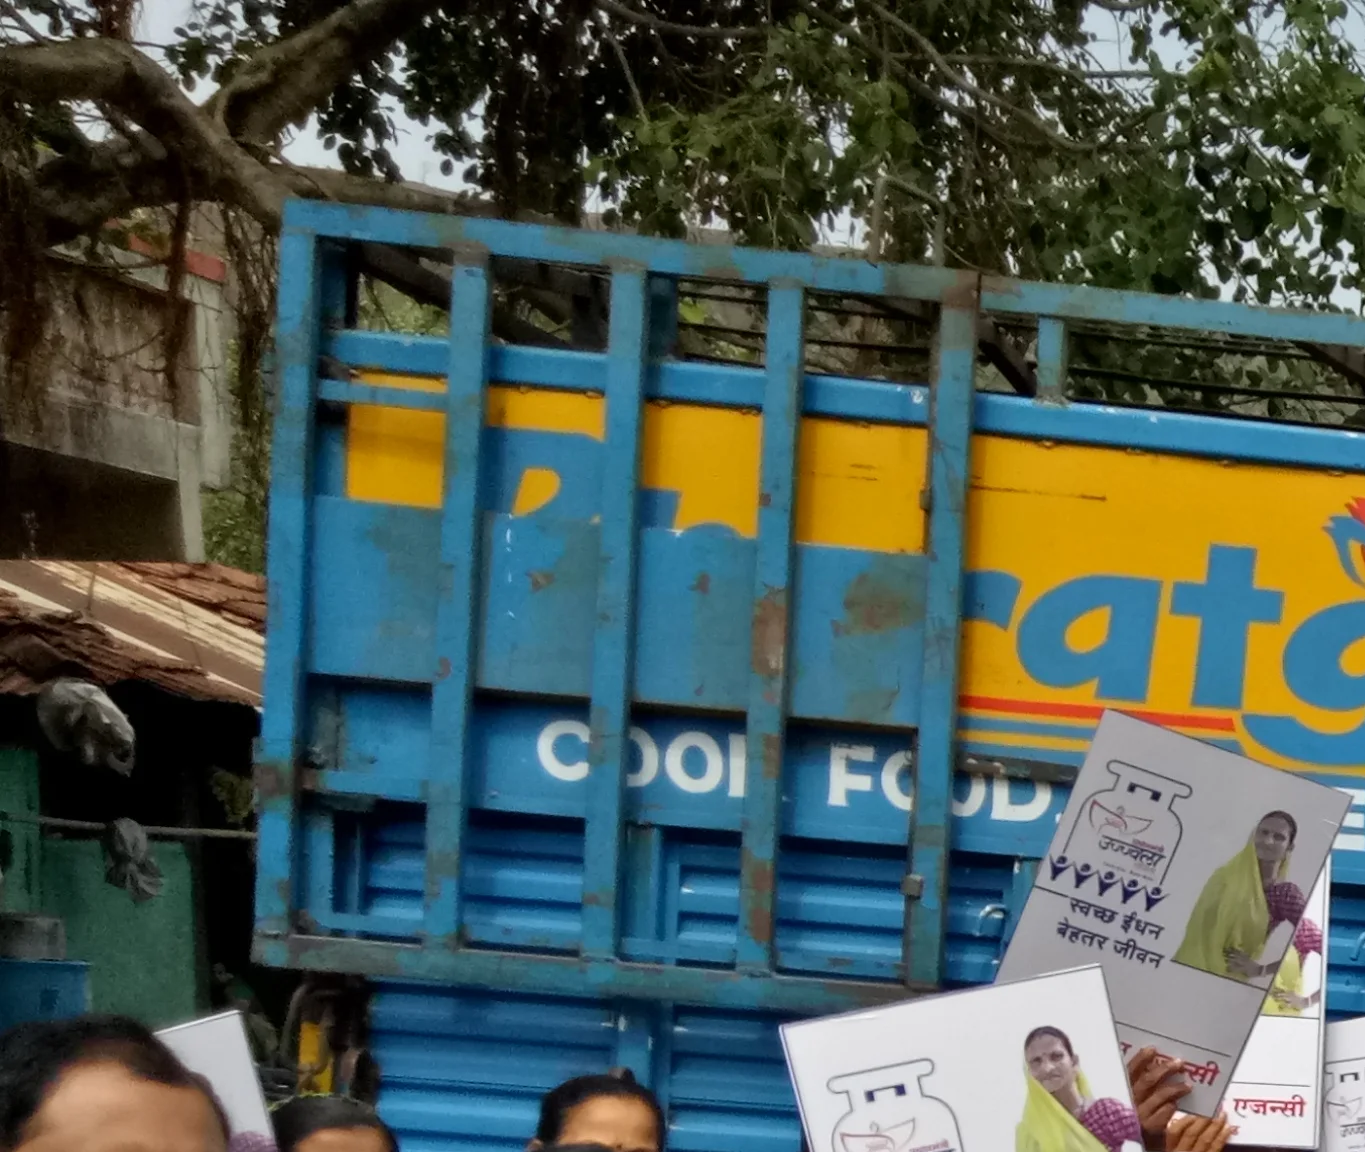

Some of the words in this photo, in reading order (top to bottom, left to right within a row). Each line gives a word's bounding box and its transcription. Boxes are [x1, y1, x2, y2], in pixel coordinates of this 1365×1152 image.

[536, 719, 789, 799] COO
[1070, 897, 1119, 924] स्वच्छ
[1057, 917, 1109, 950] बेहतर
[1113, 938, 1165, 968] जीवन
[1233, 1094, 1307, 1118] एजन्सी
